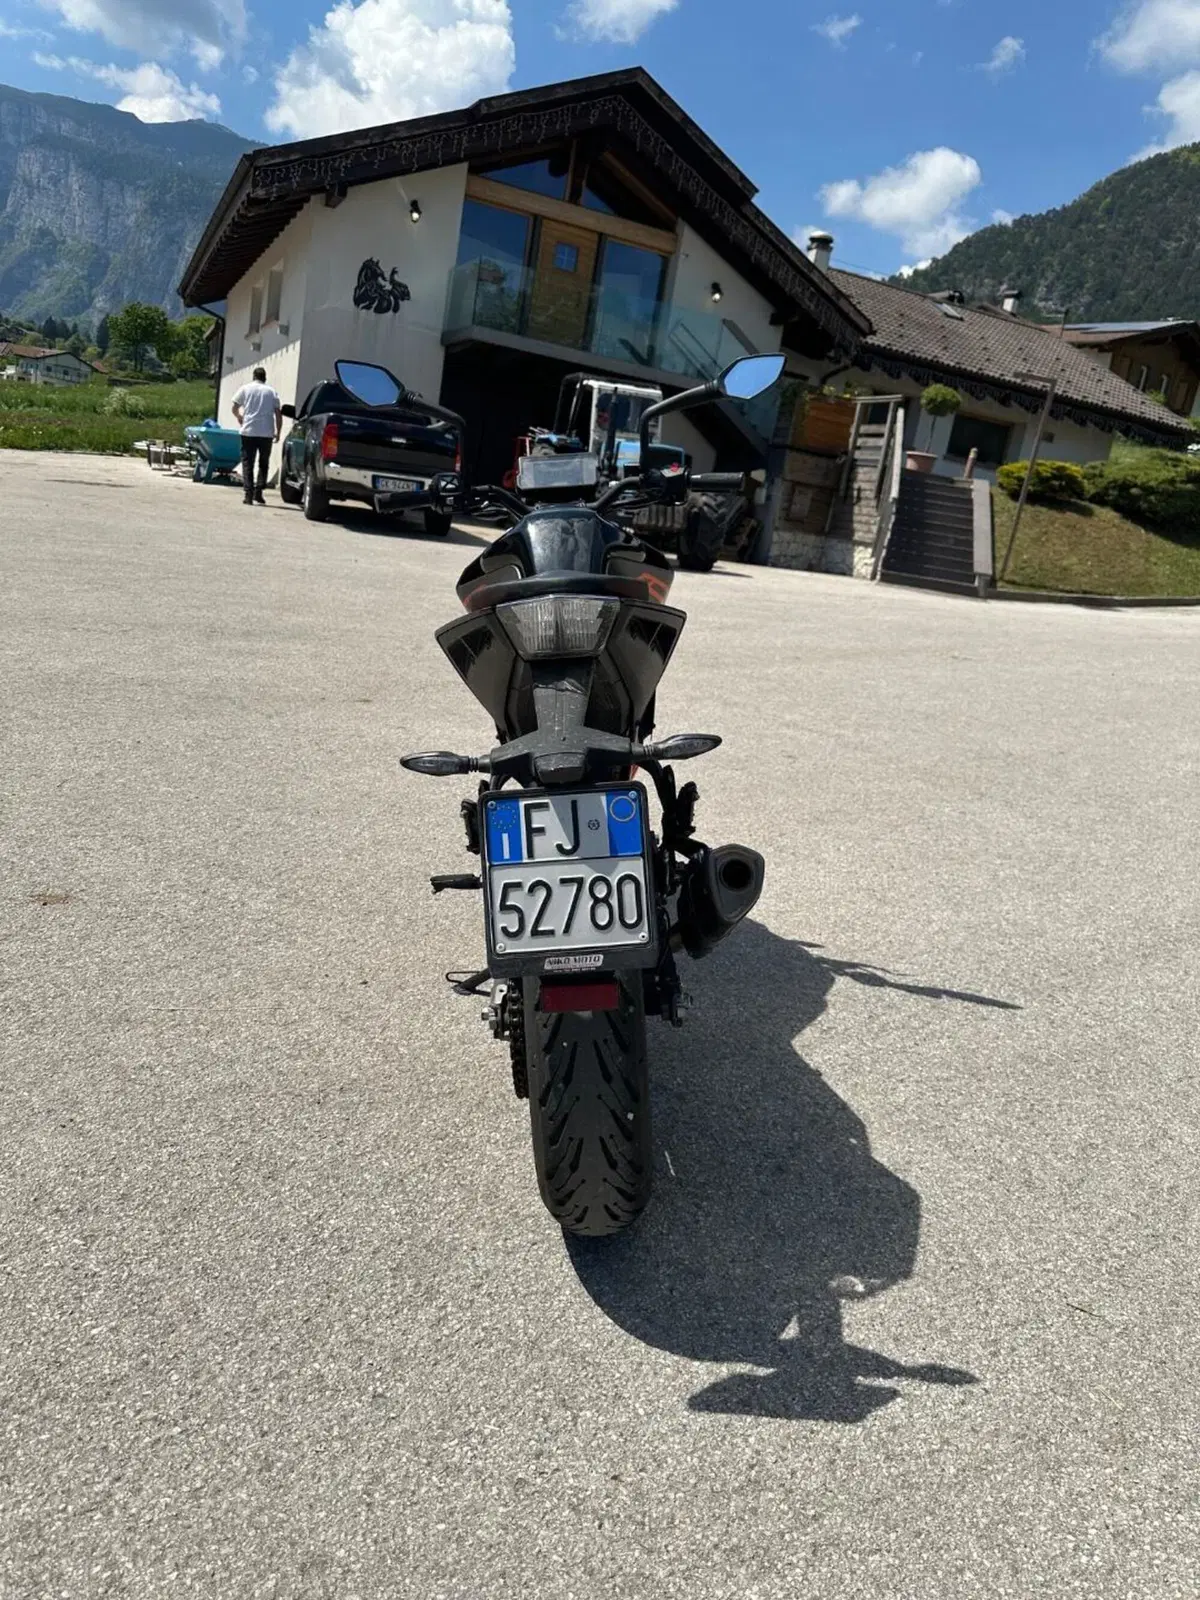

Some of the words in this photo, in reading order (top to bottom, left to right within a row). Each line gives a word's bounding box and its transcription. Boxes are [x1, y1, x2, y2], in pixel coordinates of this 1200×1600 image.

[524, 801, 580, 859] FJ
[499, 875, 643, 938] 52780
[573, 955, 600, 964] MOTO
